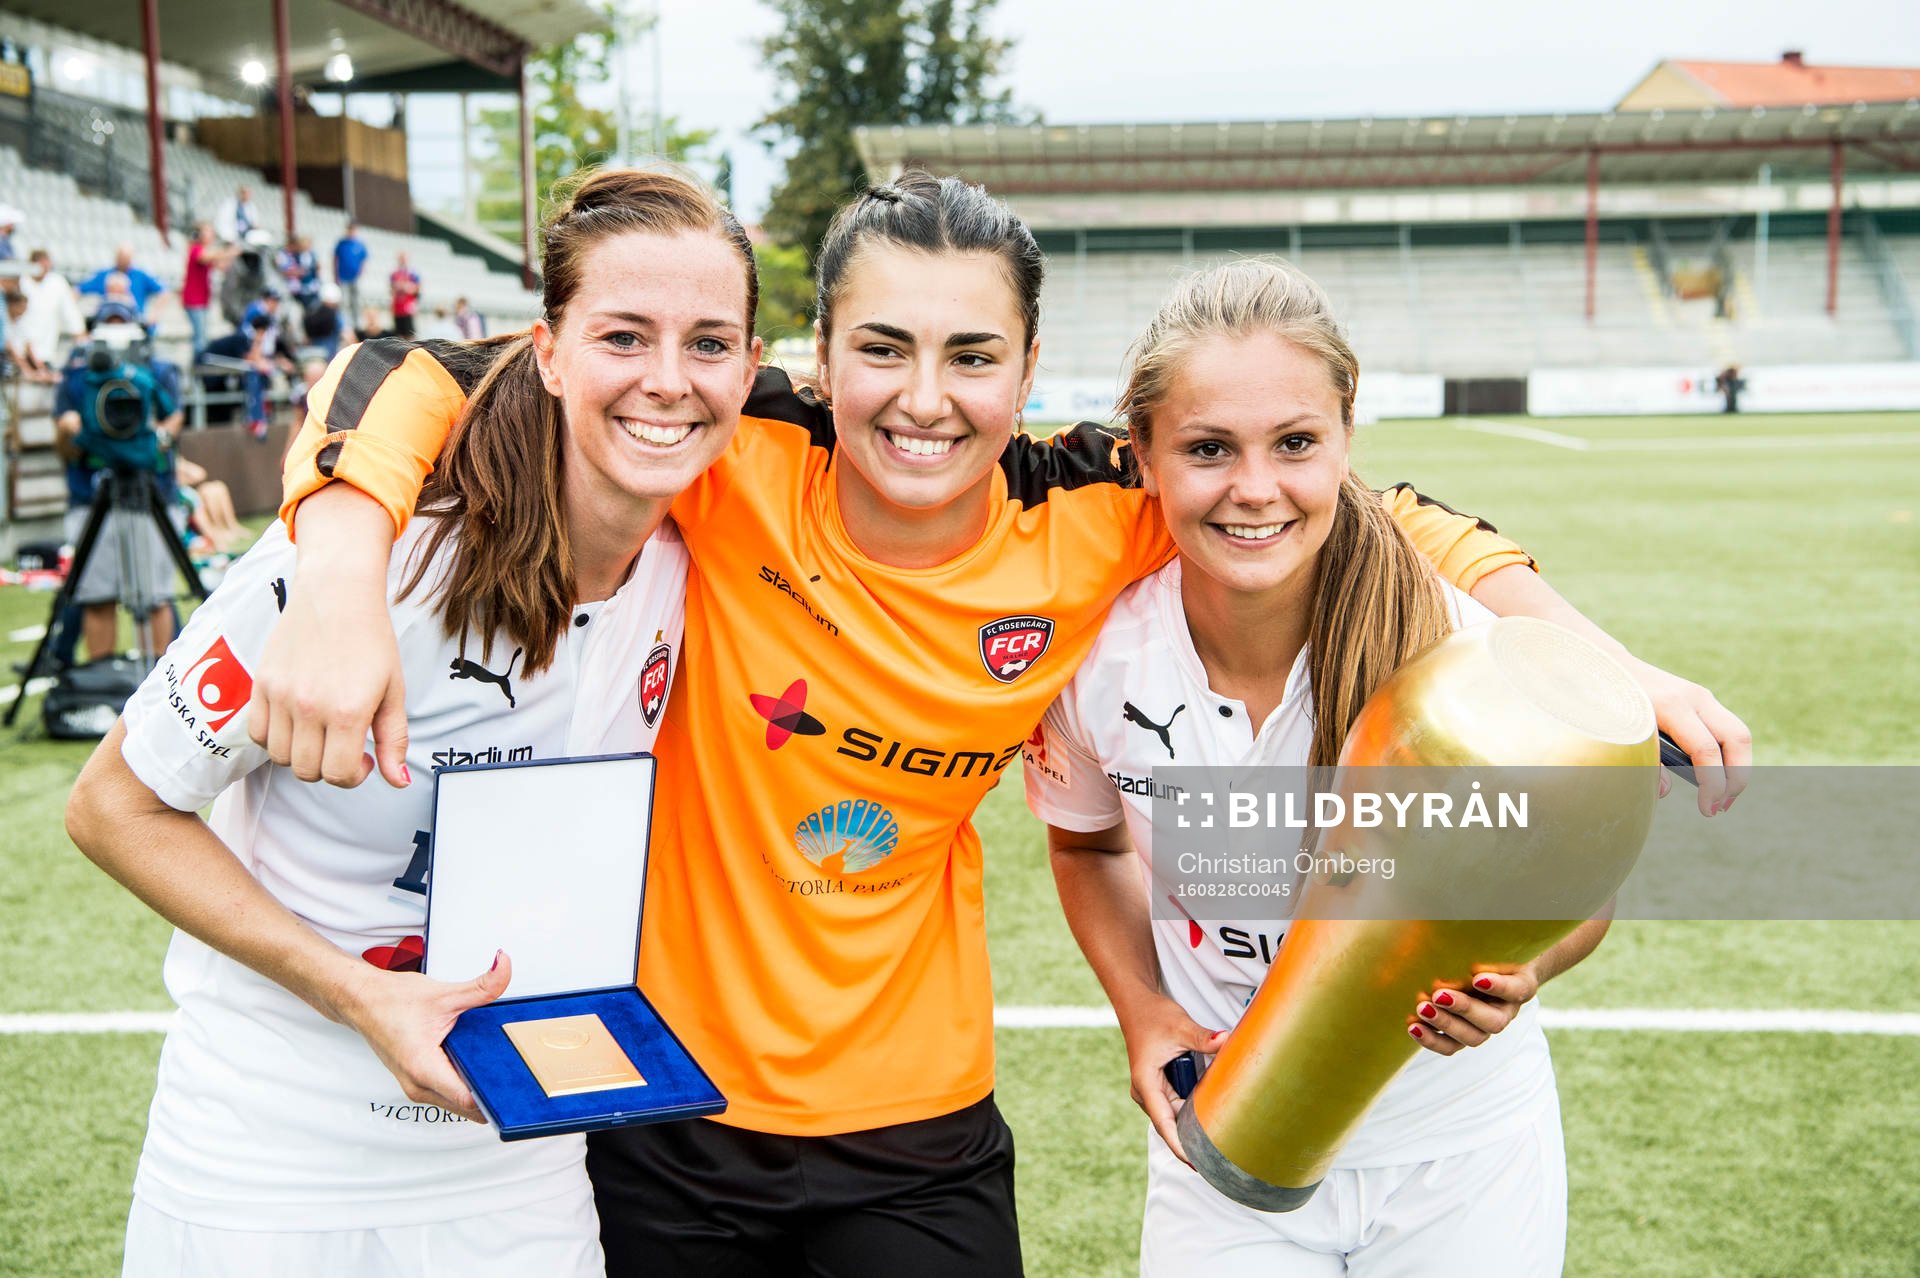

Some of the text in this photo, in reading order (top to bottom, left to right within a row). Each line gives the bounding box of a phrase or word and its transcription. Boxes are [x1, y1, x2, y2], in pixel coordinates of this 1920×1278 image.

[759, 566, 838, 636] stadium
[986, 620, 1047, 636] FC ROSENGÅRD
[990, 632, 1042, 656] FCR
[643, 663, 665, 694] FCR
[195, 729, 231, 759] SPEL
[837, 727, 1025, 778] SIGMA
[431, 745, 533, 770] stadium
[1038, 760, 1068, 785] SPEL
[852, 877, 905, 893] PARK
[1218, 926, 1285, 965] SI
[370, 1102, 469, 1124] VICTORI
